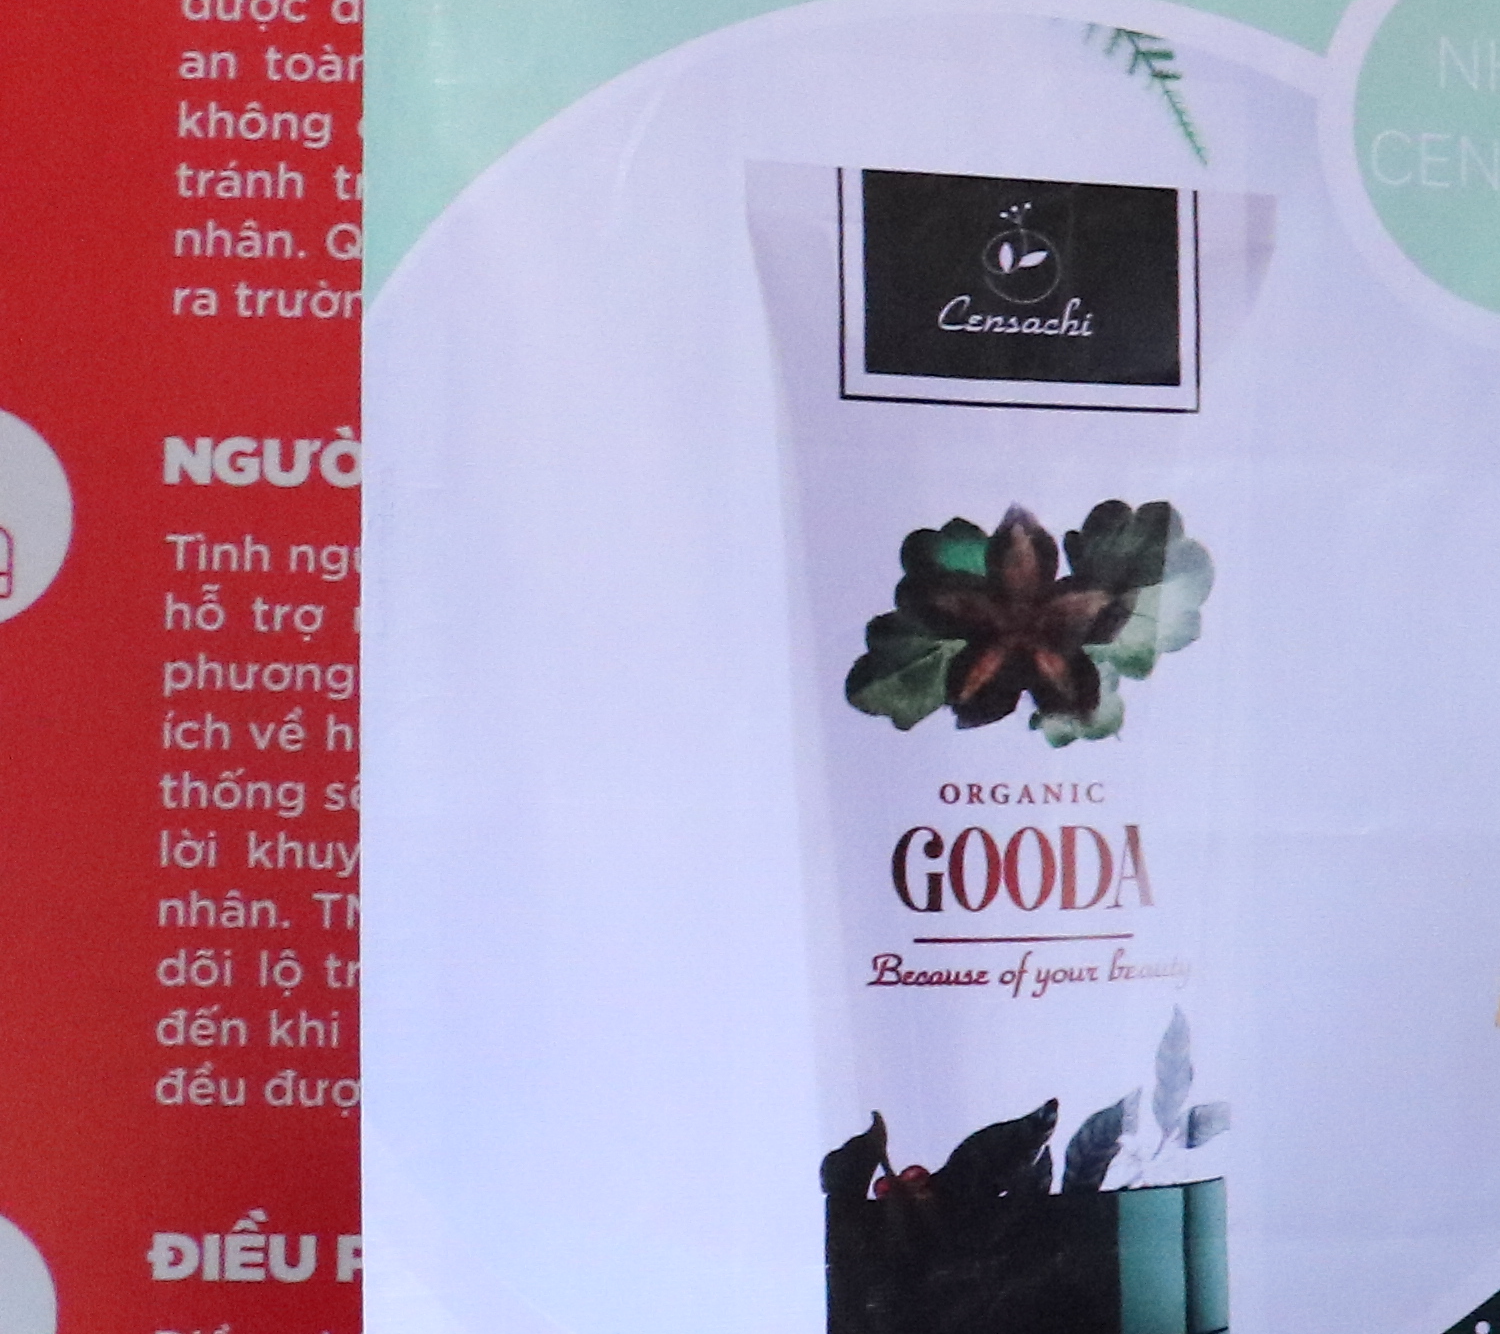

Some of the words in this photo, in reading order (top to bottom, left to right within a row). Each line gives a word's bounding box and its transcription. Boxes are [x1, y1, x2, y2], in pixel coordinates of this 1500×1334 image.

[179, 51, 238, 79] an
[178, 101, 332, 149] không
[176, 161, 304, 198] tránh
[174, 219, 307, 258] nhân.
[172, 286, 218, 317] ra
[938, 294, 1095, 337] Censachi
[166, 534, 270, 572] Tình
[164, 584, 225, 631] hỗ
[252, 597, 324, 641] trợ
[163, 653, 355, 700] phương
[162, 711, 231, 751] ích
[250, 707, 306, 751] về
[159, 768, 306, 818] thống
[940, 783, 1104, 804] ORGANIC
[160, 828, 217, 868] lời
[892, 825, 1155, 913] GOODA
[158, 889, 291, 929] nhân.
[156, 948, 232, 987] dõi
[259, 948, 304, 997] lộ
[866, 954, 990, 986] Because
[1000, 950, 1033, 998] of
[1032, 966, 1098, 998] your
[156, 1003, 247, 1047] đến
[269, 1009, 339, 1048] khi
[155, 1060, 245, 1106] đều
[146, 1207, 317, 1282] ĐIỀU
